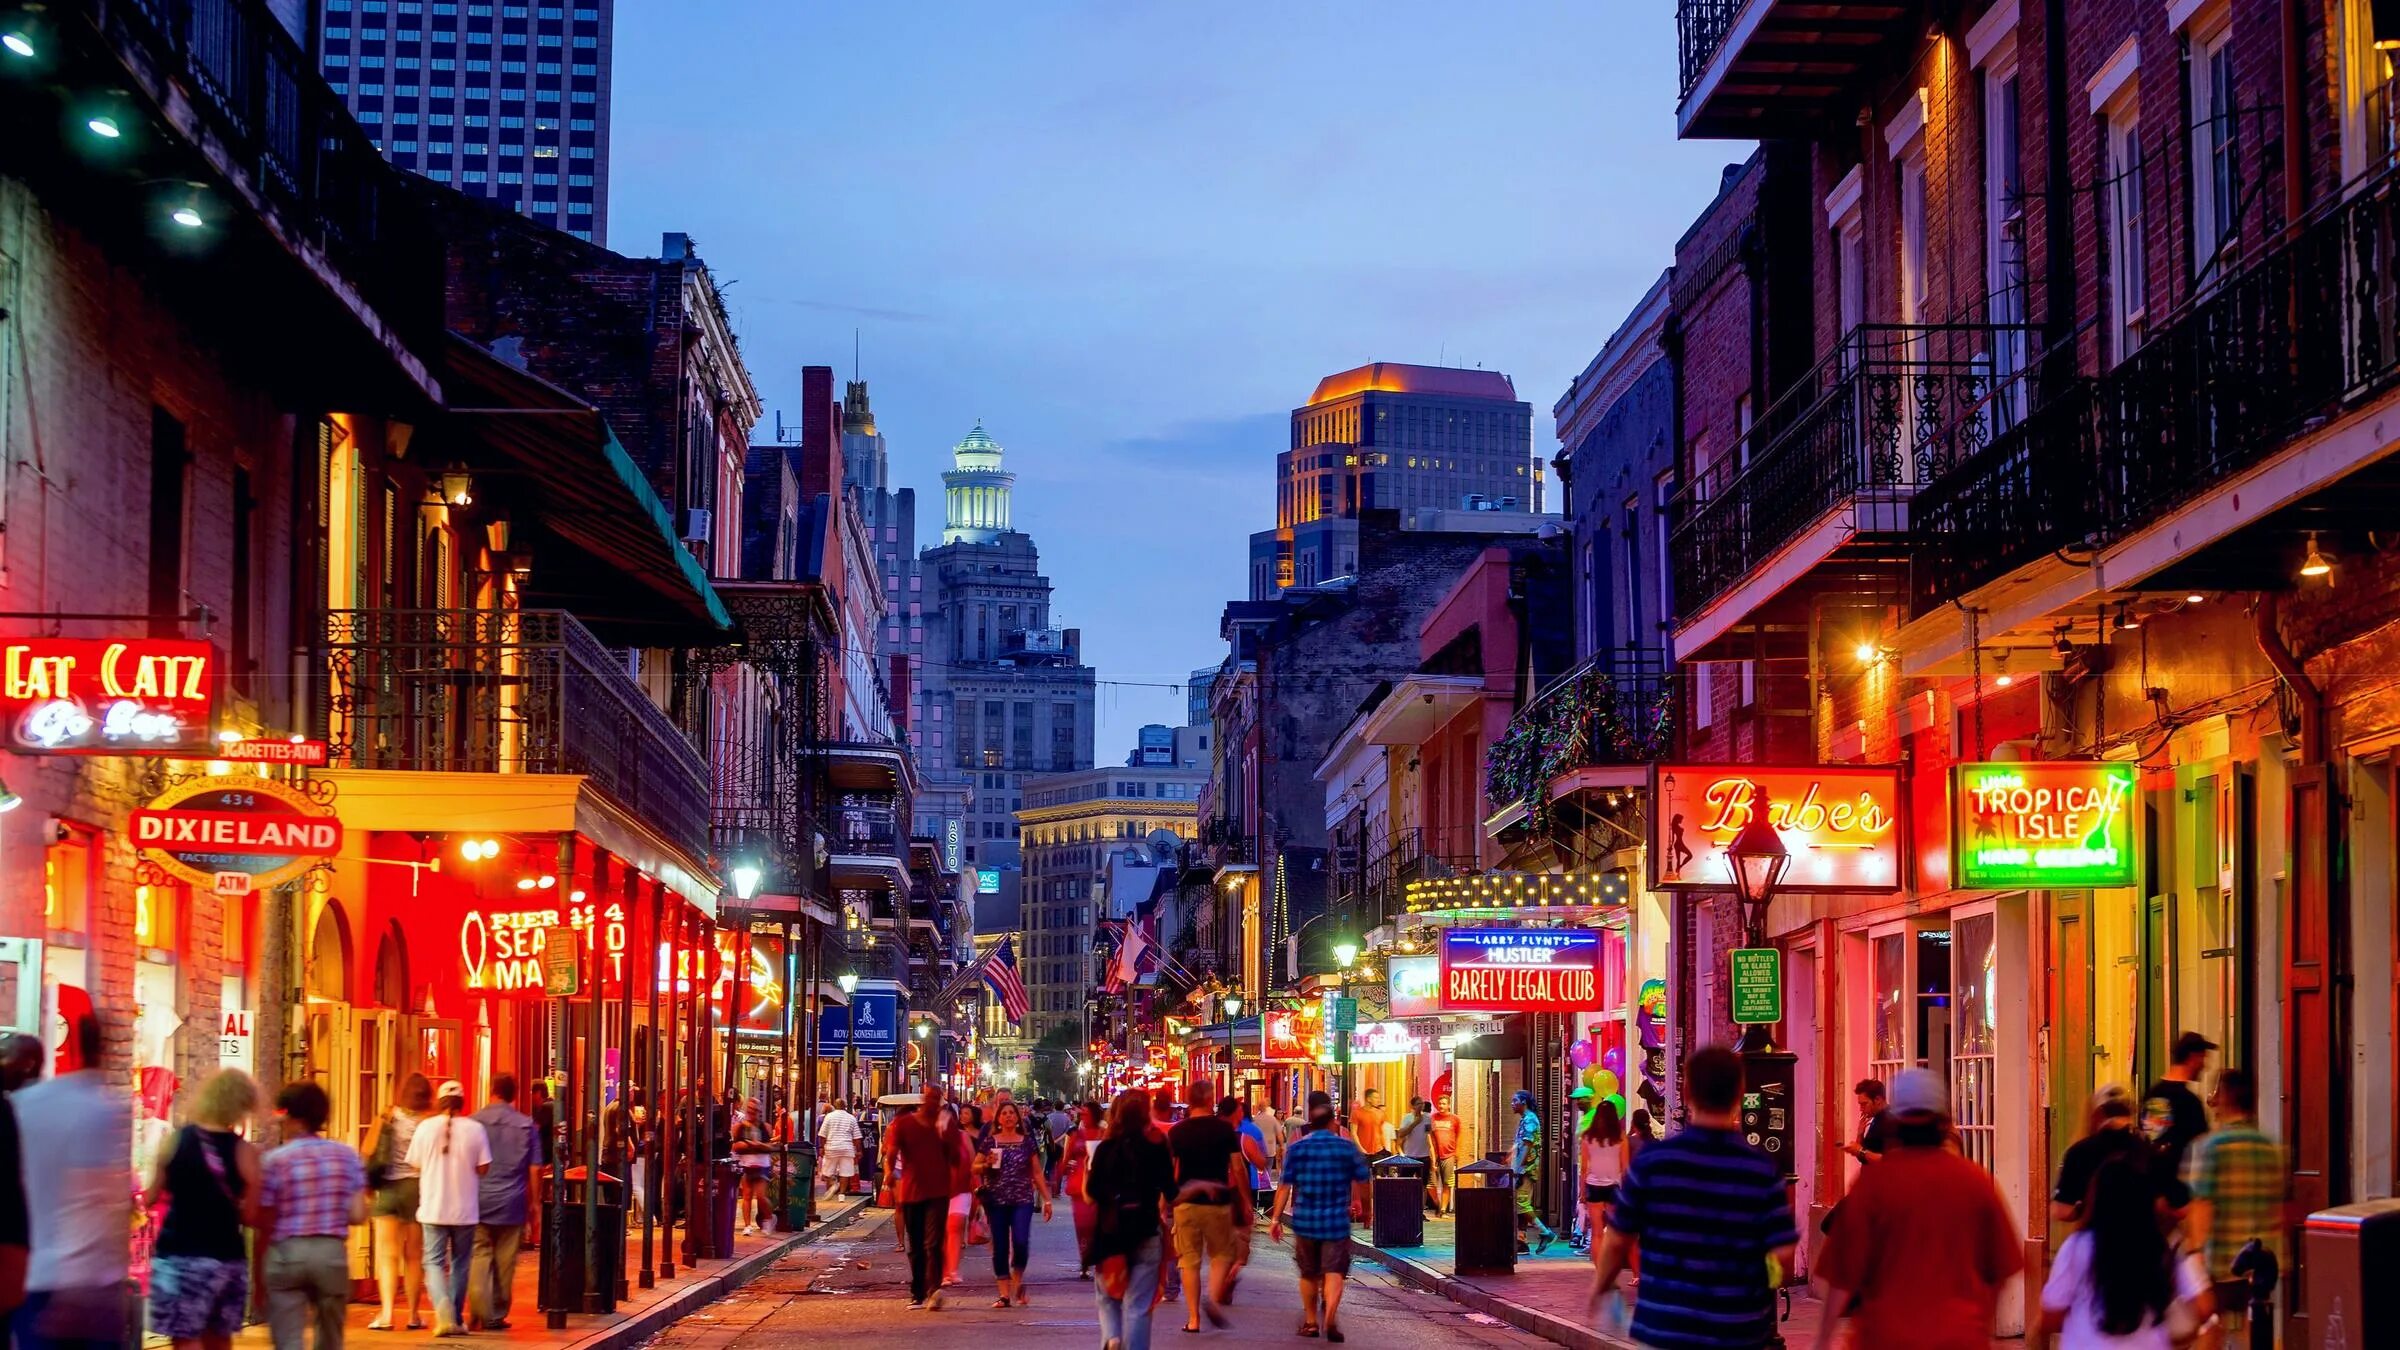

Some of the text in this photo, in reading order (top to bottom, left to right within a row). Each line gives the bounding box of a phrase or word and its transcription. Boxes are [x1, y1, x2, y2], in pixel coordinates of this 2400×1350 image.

[220, 793, 254, 807] 434
[1701, 778, 1894, 832] Babe's
[1971, 787, 2121, 814] TROPICAL
[138, 816, 337, 848] DIXIELAND
[2018, 813, 2080, 839] ISLE
[948, 820, 958, 873] ASTO
[178, 852, 234, 865] FACTORY
[217, 875, 248, 891] ATM
[980, 873, 997, 883] AC
[490, 910, 560, 930] PIER
[1475, 935, 1571, 946] LARRY FLYNT'S
[1488, 948, 1552, 963] HUSTLER
[1742, 969, 1771, 977] ALLOWED
[1450, 970, 1506, 1001] BARELY
[1510, 970, 1555, 1002] LEGAL
[1558, 970, 1595, 1001] CLUB
[1410, 1025, 1442, 1035] FRESH
[1472, 1022, 1503, 1033] GRILL
